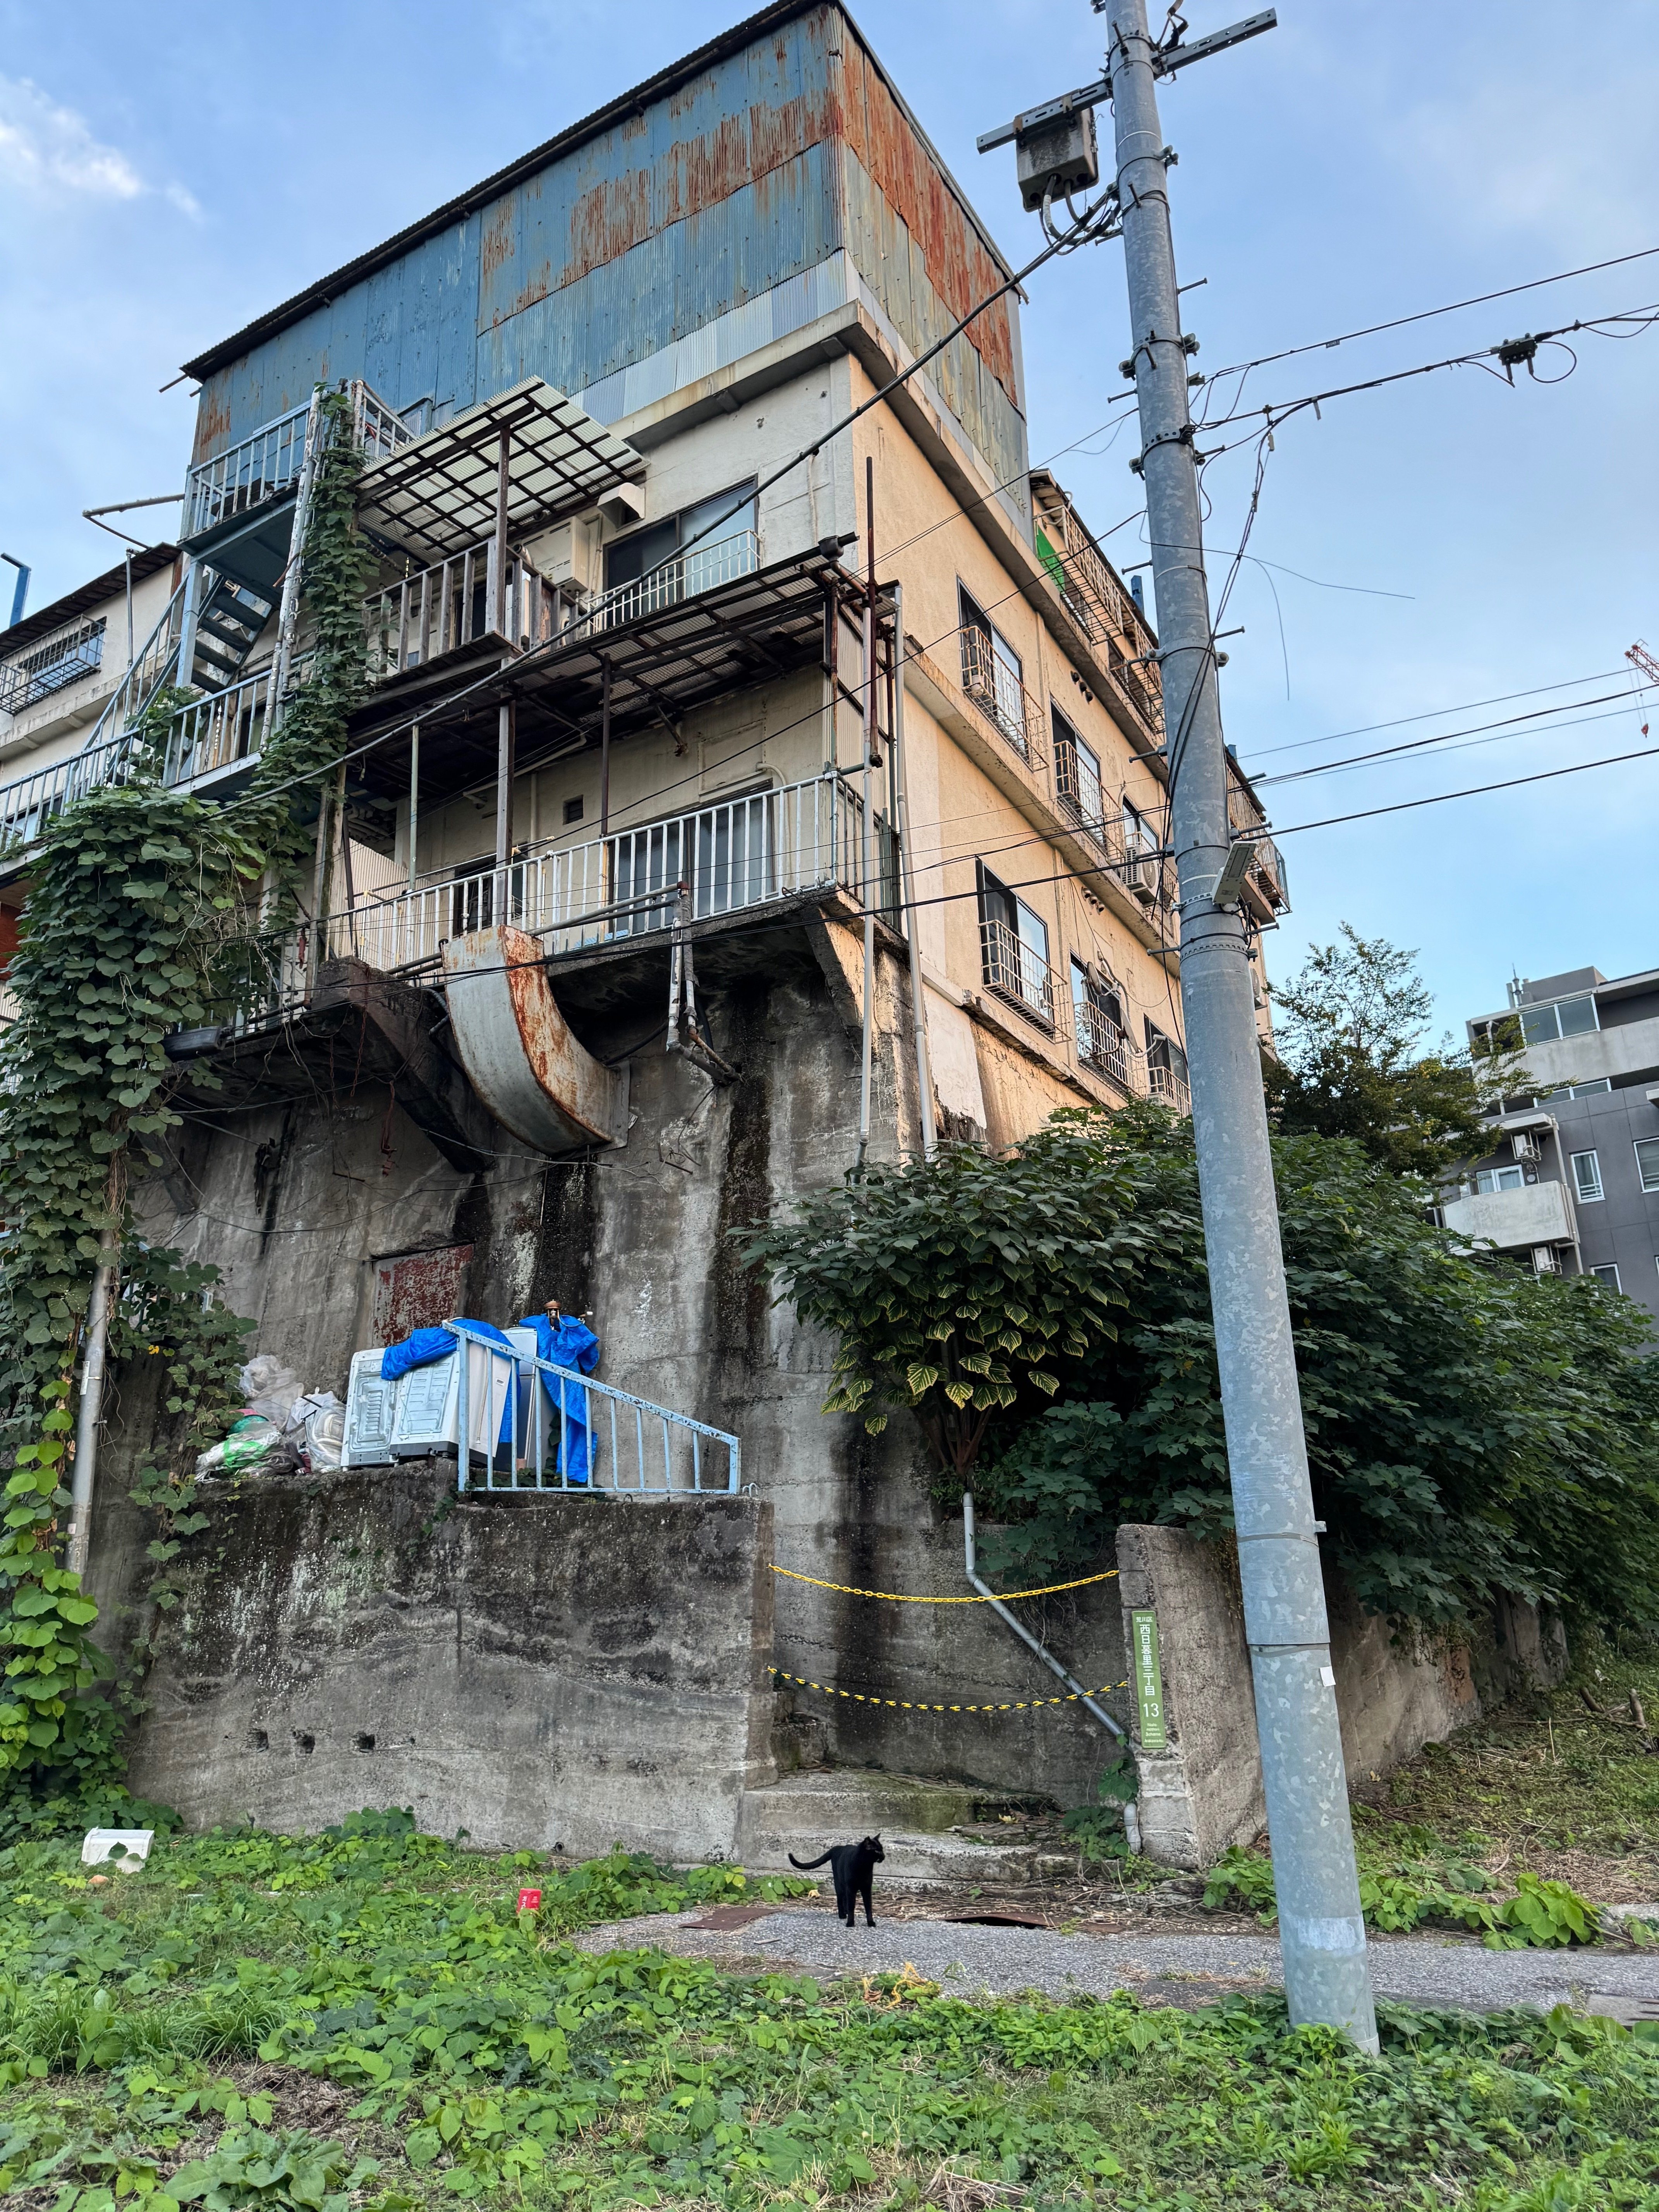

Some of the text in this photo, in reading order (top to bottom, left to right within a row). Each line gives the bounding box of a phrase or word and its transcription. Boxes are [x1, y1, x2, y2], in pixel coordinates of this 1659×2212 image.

[1139, 1624, 1155, 1696] 西日暮里三丁目
[1143, 1703, 1159, 1717] 13
